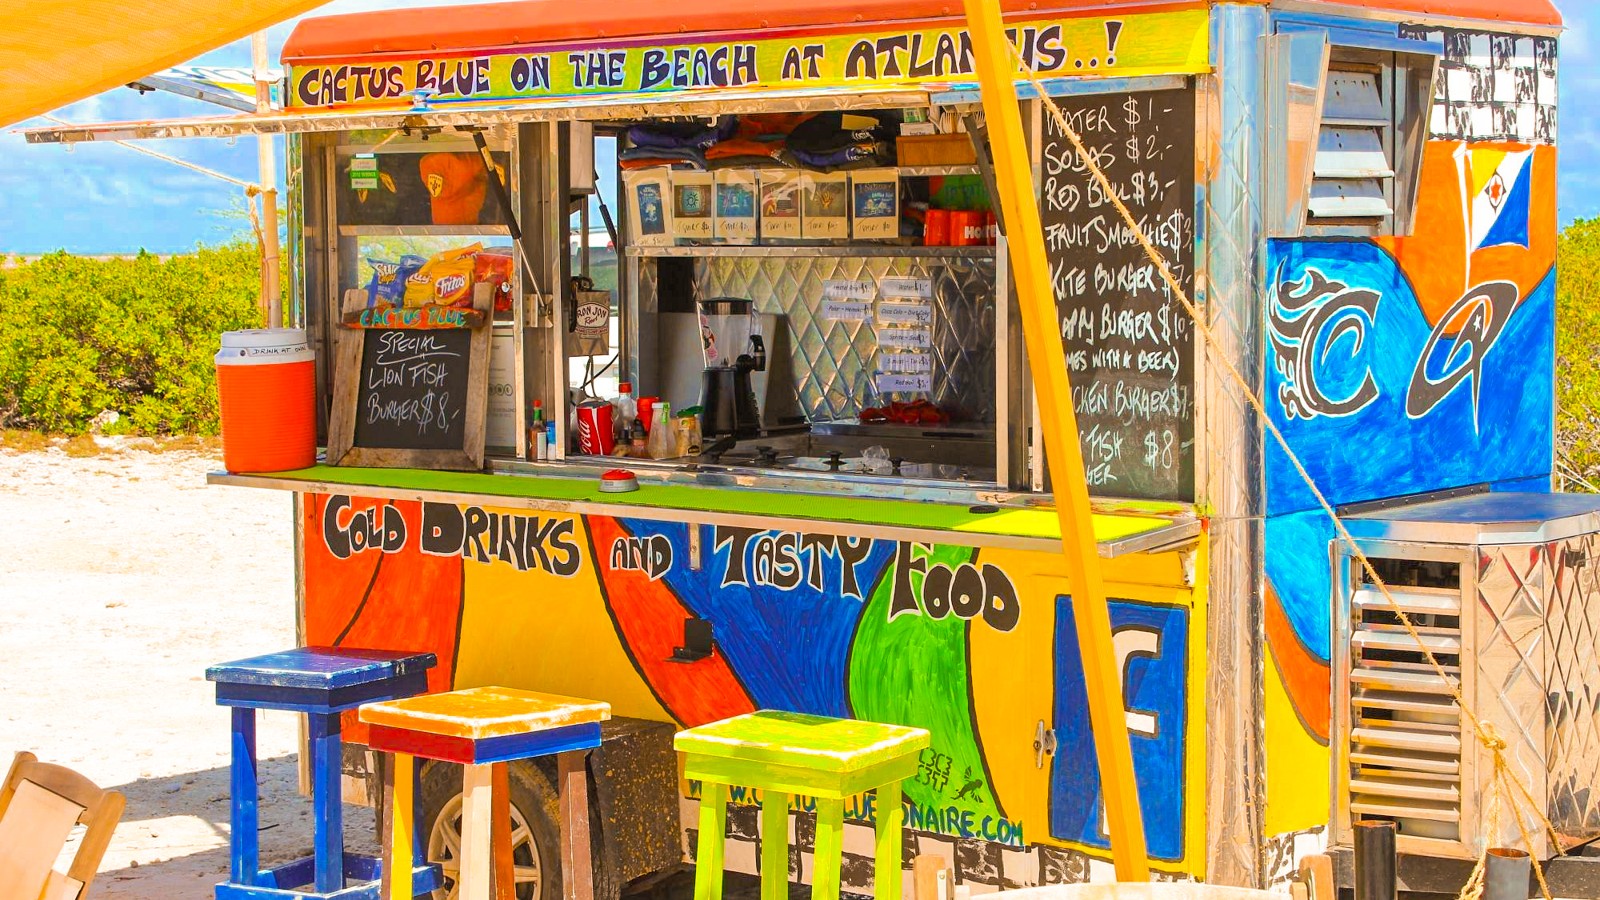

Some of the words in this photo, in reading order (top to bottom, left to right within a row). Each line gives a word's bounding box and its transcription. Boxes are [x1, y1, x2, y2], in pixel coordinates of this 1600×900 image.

[298, 66, 403, 105] CACTUS
[415, 56, 491, 93] BLUE
[510, 49, 551, 93] ON
[568, 48, 627, 89] THE
[639, 44, 758, 91] BEACH
[780, 44, 825, 80] AT
[844, 20, 1123, 81] ATLANIS..!
[1045, 105, 1116, 137] WATER
[1044, 142, 1116, 175] SODAS
[1045, 177, 1080, 212] RED
[1045, 222, 1094, 252] FRUIT
[435, 275, 466, 297] Fritos
[1094, 262, 1157, 297] BURGER
[360, 308, 421, 327] CACTUS
[1055, 305, 1095, 345] APPY
[1100, 303, 1159, 345] BURGER
[376, 331, 446, 354] SPECIAL
[368, 363, 404, 389] LION
[408, 361, 449, 388] FISH
[1065, 350, 1088, 371] MES
[1092, 348, 1120, 369] WITH
[367, 392, 421, 428] BURGER
[1073, 380, 1108, 415] CKEN
[1115, 380, 1172, 423] BURGER
[1086, 423, 1124, 462] FISH
[1086, 462, 1118, 485] GER
[323, 494, 407, 559] COLD
[420, 501, 580, 578] DRINKS
[610, 534, 673, 582] AND
[713, 524, 875, 603] TASTY
[887, 540, 1022, 633] FOOD
